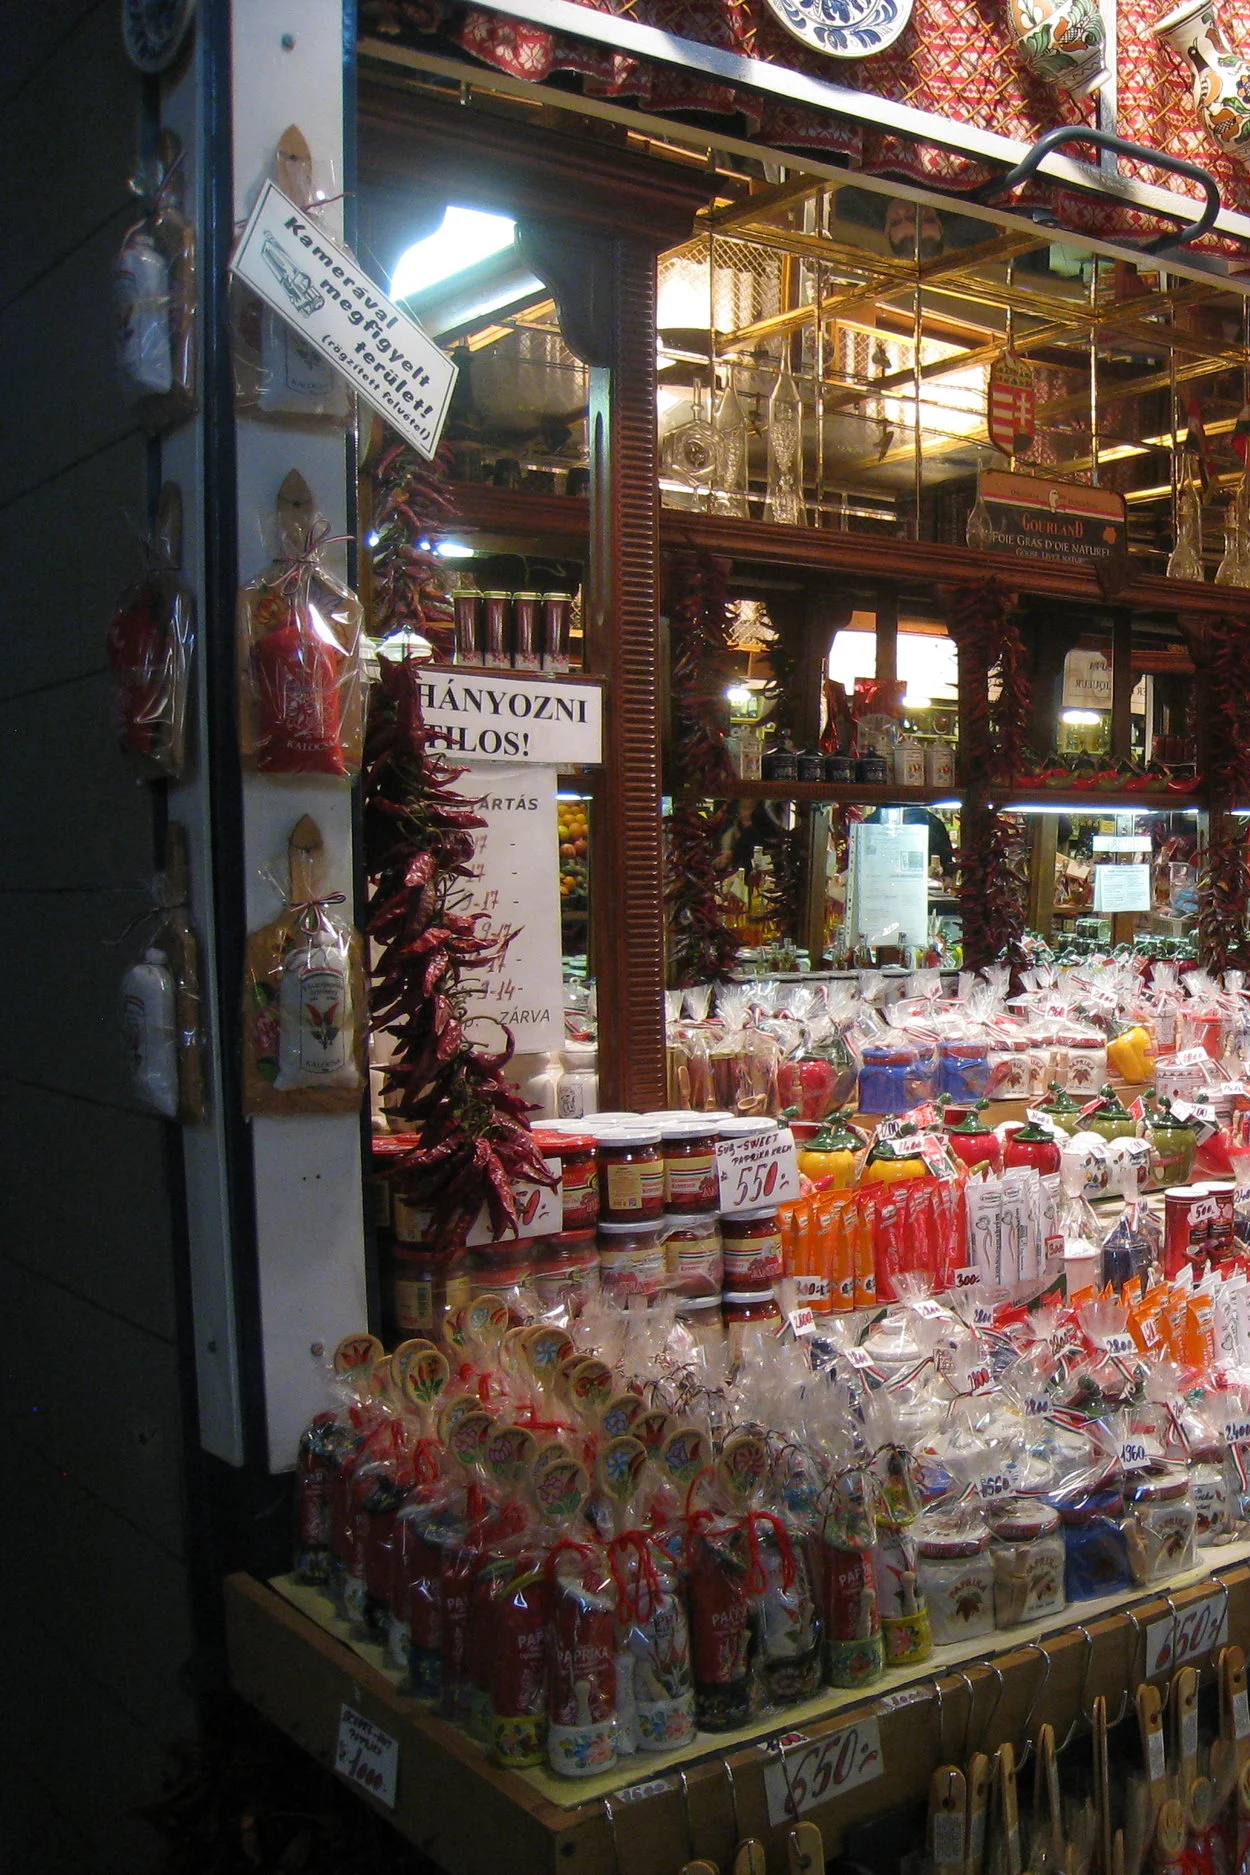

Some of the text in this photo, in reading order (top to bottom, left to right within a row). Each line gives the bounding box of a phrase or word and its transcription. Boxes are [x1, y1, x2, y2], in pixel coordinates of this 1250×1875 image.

[284, 217, 399, 330] Kamerával
[320, 279, 431, 388] megfigyelt
[355, 341, 434, 419] terület!
[419, 678, 588, 723] HÁNYOZNI
[500, 1006, 550, 1026] ZÁRVA
